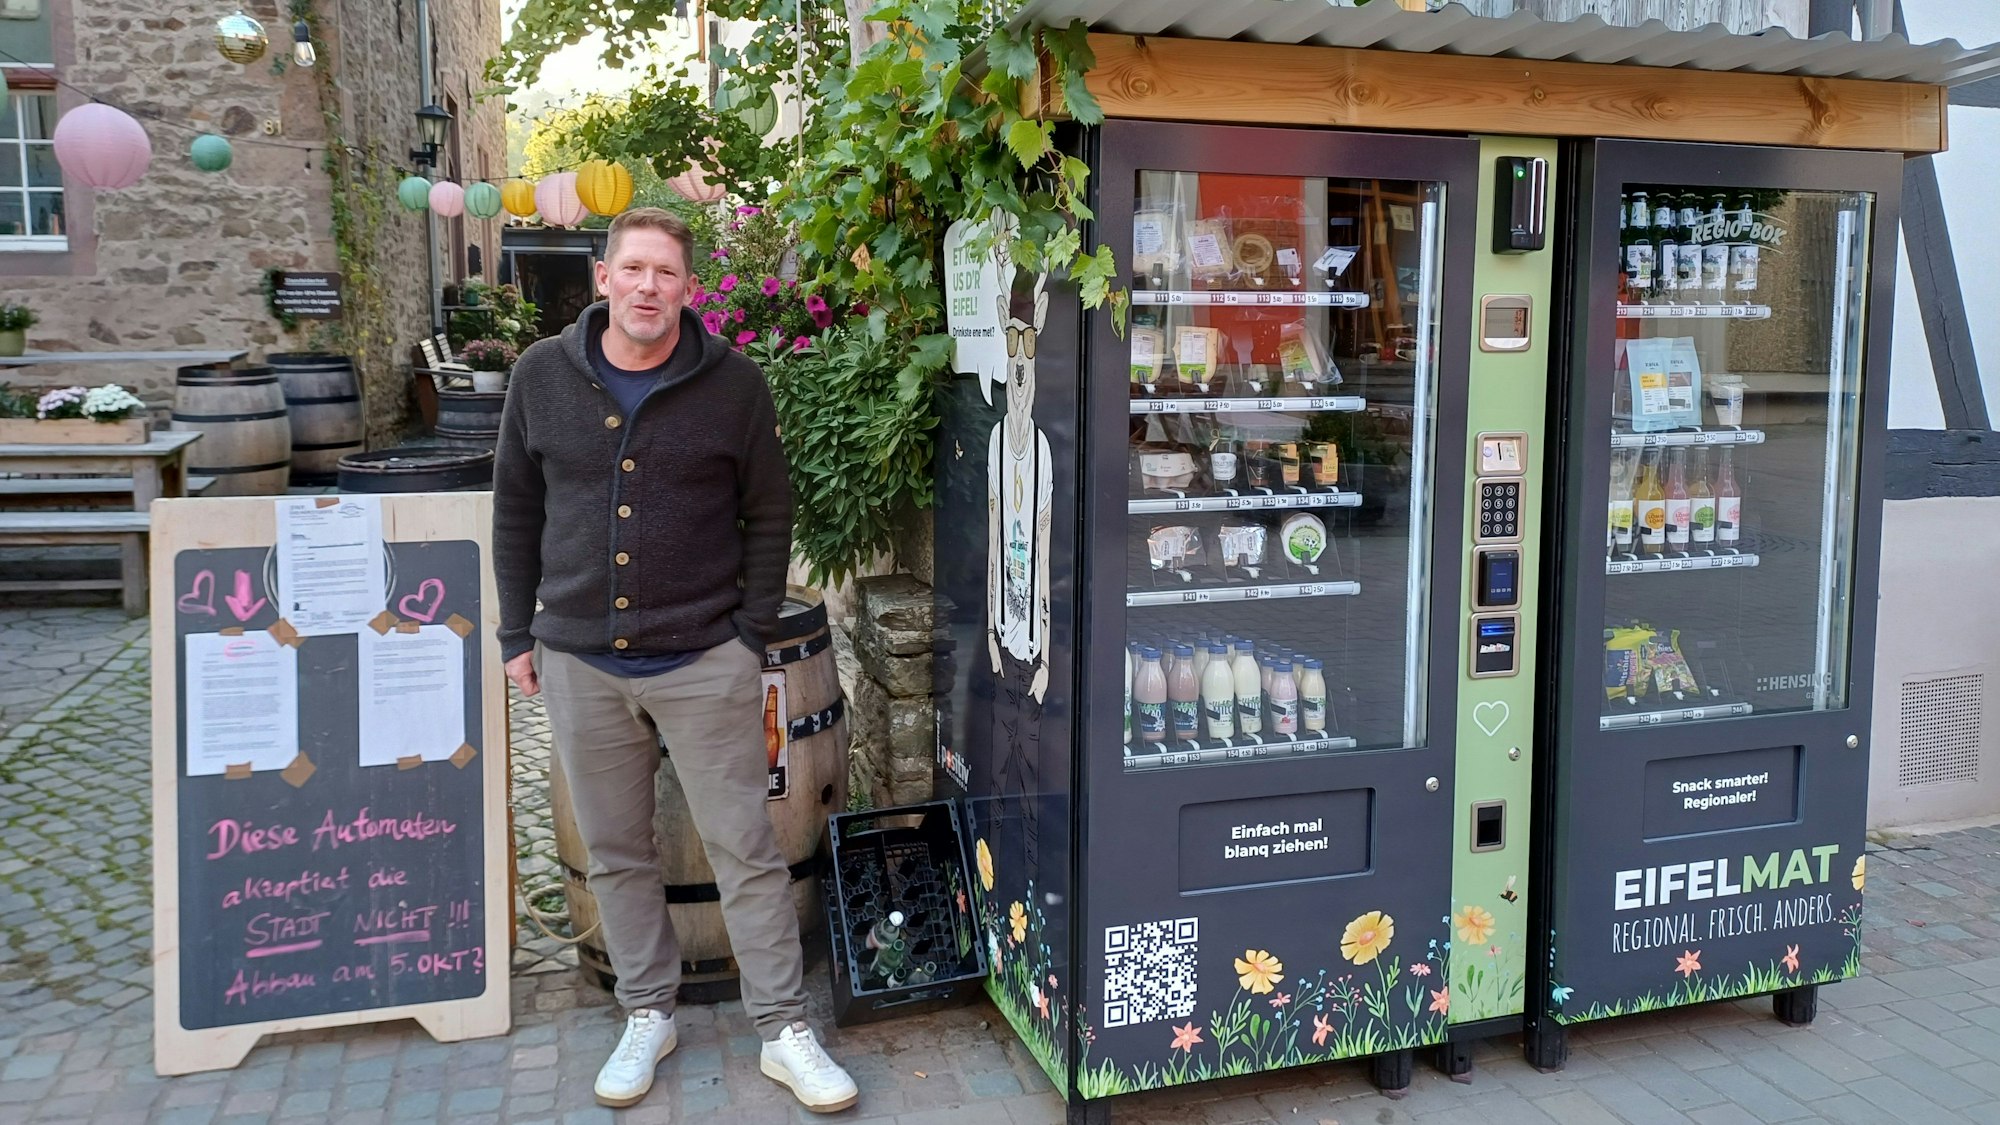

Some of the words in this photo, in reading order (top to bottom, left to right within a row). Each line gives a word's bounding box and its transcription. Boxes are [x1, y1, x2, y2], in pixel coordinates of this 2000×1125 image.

[263, 118, 282, 136] 81
[1691, 219, 1788, 246] REGIO-BOX
[953, 247, 963, 266] ET
[953, 272, 964, 292] US
[953, 296, 978, 317] EIFEL!
[1156, 293, 1169, 303] 111
[1211, 294, 1224, 303] 112
[1258, 294, 1270, 303] 113
[1150, 402, 1163, 411] 121
[1177, 500, 1189, 510] 131
[1228, 499, 1239, 508] 132
[1326, 495, 1338, 504] 135
[1184, 592, 1196, 601] 141
[1246, 589, 1258, 598] 142
[1162, 756, 1174, 764] 152
[1188, 753, 1200, 761] 153
[1227, 750, 1239, 758] 154
[1255, 747, 1267, 755] 155
[1292, 744, 1304, 752] 156
[1672, 778, 1713, 794] Snack
[1715, 772, 1769, 789] smarter!
[1684, 790, 1757, 810] Regionaler!
[206, 818, 300, 860] Diese
[312, 806, 457, 852] Automaten
[1231, 821, 1290, 840] Einfach
[1293, 818, 1323, 834] mal
[1224, 844, 1269, 859] blanq
[1272, 836, 1329, 854] ziehen!
[368, 867, 408, 888] die
[1614, 844, 1840, 911] EIFELMAT
[244, 912, 331, 945] STADT
[353, 905, 439, 933] NICHT
[1613, 912, 1703, 954] REGIONAL.
[1709, 902, 1768, 939] FRISCH.
[1773, 893, 1837, 930] ANDERS.
[225, 969, 316, 1005] Abbau
[332, 965, 376, 984] am
